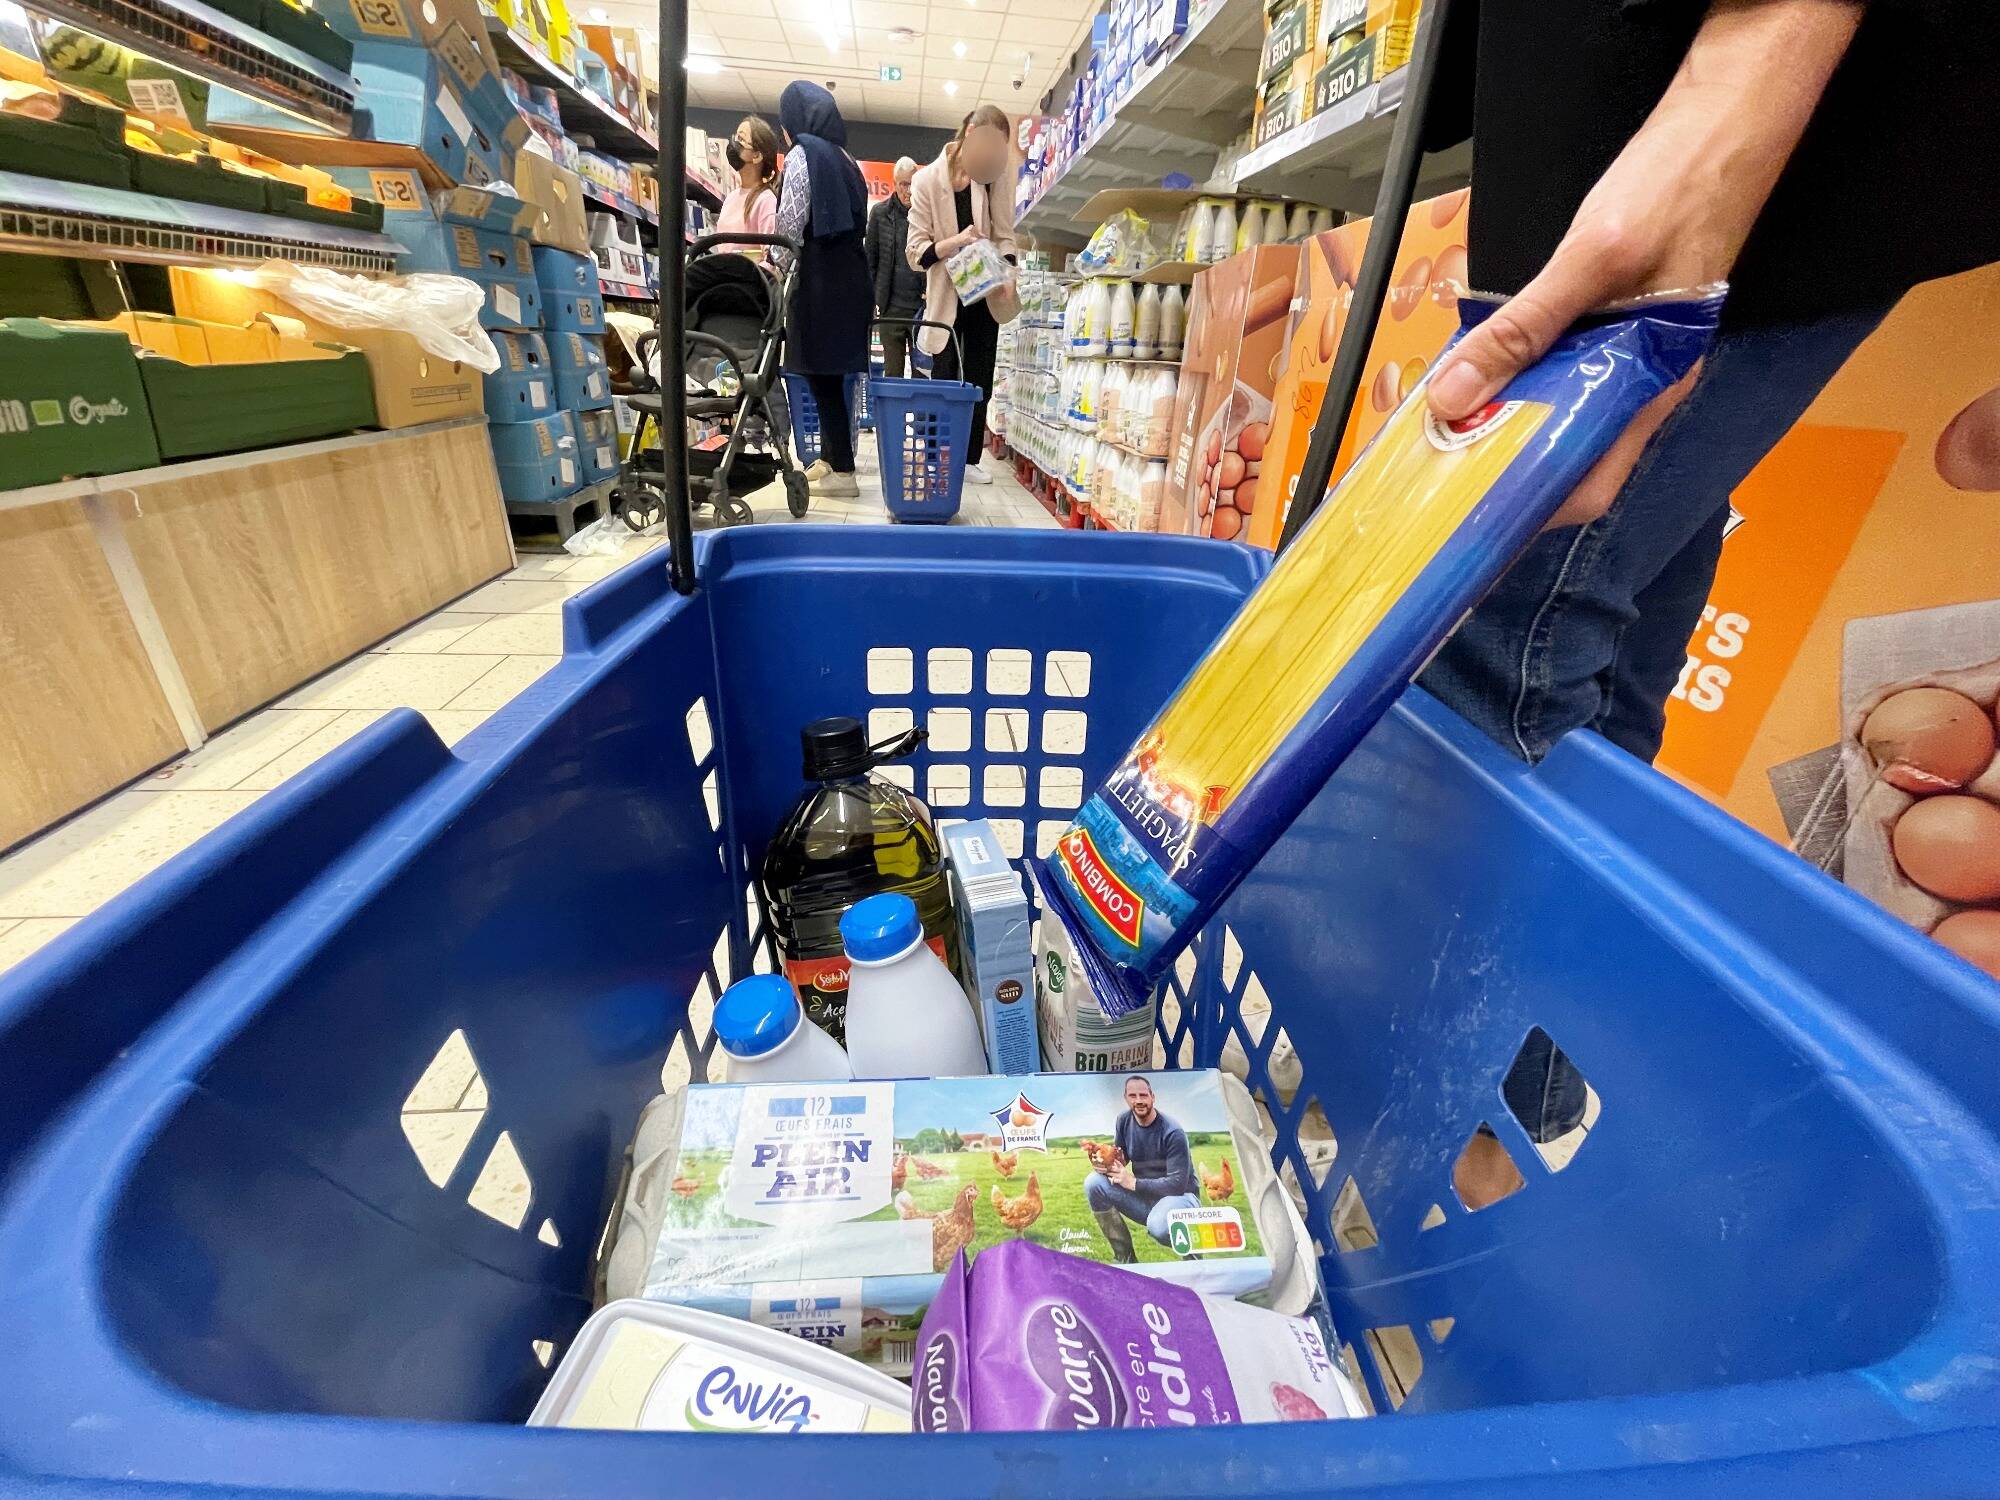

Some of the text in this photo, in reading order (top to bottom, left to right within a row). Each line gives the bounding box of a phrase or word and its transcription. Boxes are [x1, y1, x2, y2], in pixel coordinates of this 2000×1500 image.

[1272, 34, 1291, 67] BIO
[1328, 68, 1355, 105] BIO
[1266, 112, 1284, 139] BIO
[1105, 769, 1197, 871] SPAGHETTI
[1069, 832, 1135, 923] COMBINO
[1111, 1041, 1149, 1065] FARINE
[810, 1096, 826, 1117] 12
[815, 1117, 853, 1130] FRAIS
[751, 1140, 873, 1168] PLEIN
[766, 1166, 851, 1199] AIR
[1172, 1210, 1222, 1220] NUTRI-SCORE
[1174, 1229, 1188, 1247] A
[800, 1298, 811, 1311] 12
[1051, 1304, 1100, 1430] varre
[1127, 1342, 1145, 1377] en
[1302, 1346, 1322, 1384] POIDS
